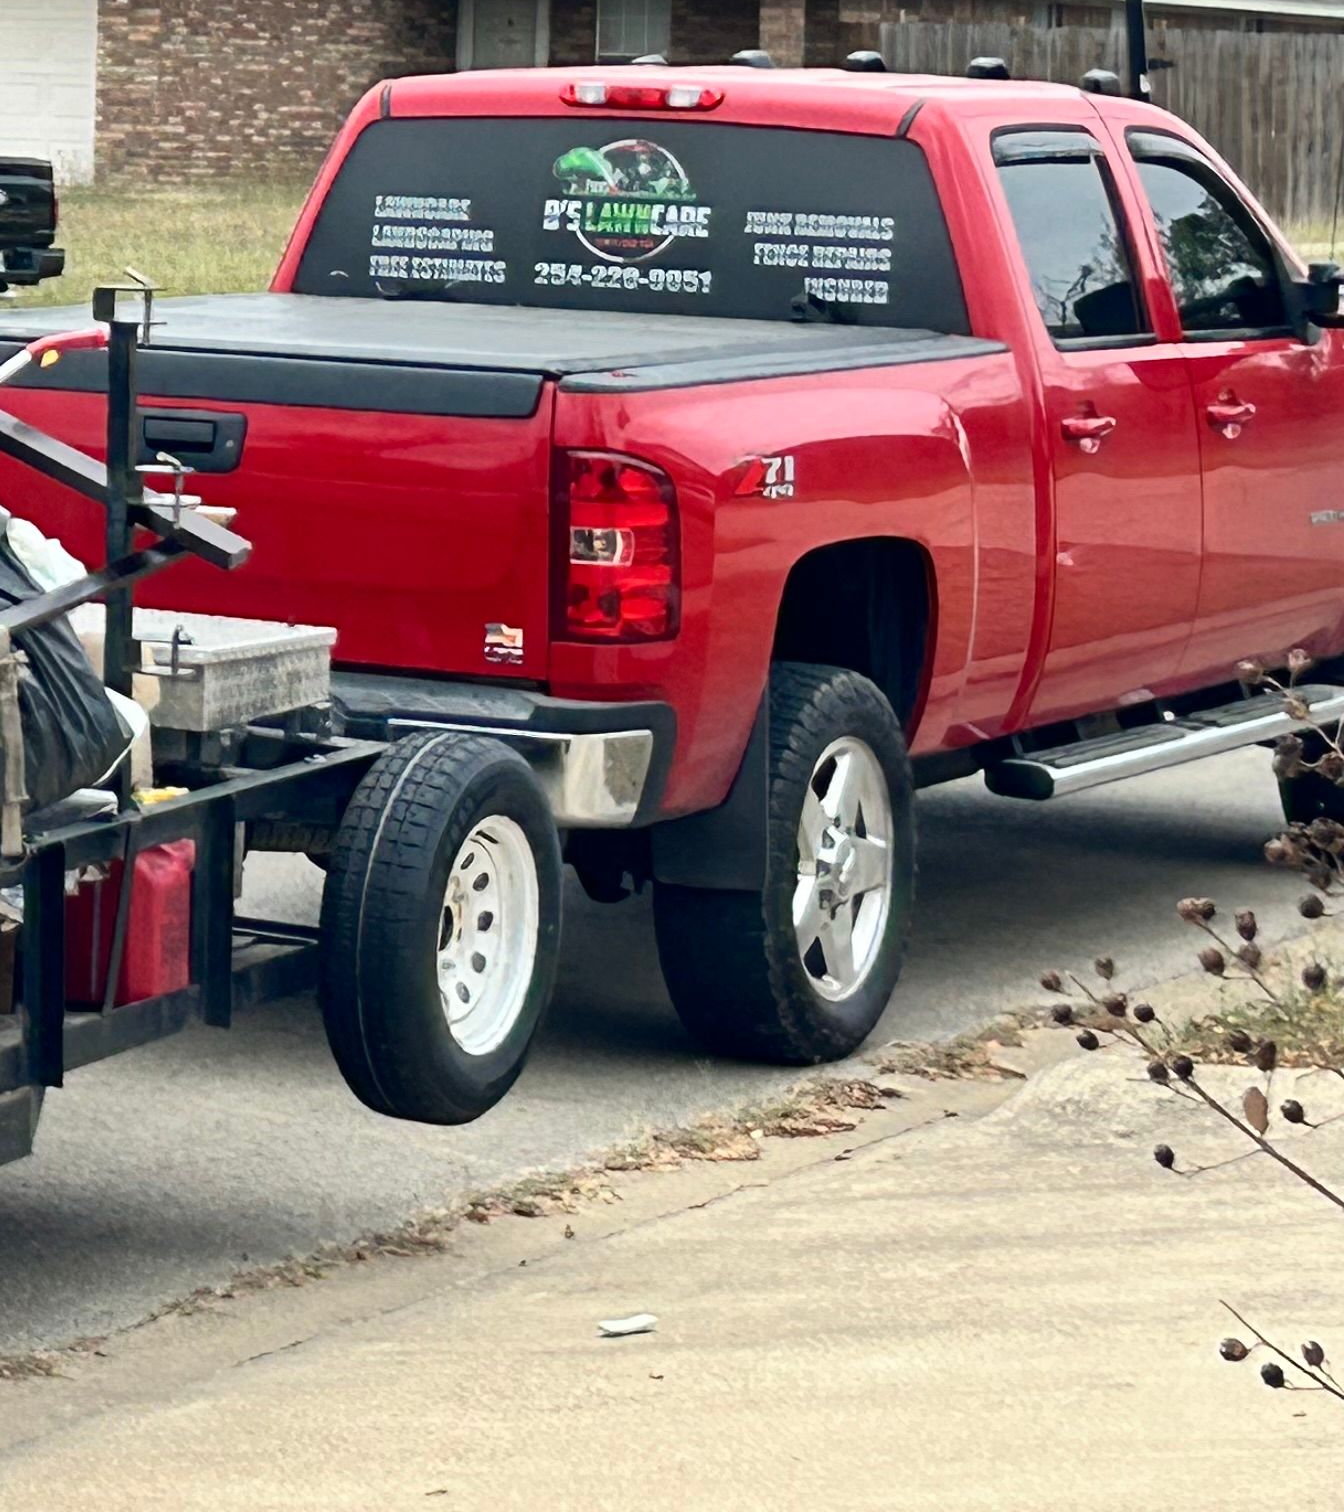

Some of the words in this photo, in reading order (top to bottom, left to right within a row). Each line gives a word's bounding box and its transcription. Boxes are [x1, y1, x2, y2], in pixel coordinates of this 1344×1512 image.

[542, 199, 583, 231] D'S
[584, 201, 712, 238] LAWNCARE
[371, 224, 494, 253] LANDSCAPING
[368, 255, 410, 279] FREE
[410, 256, 507, 284] ESTIMATES
[533, 262, 713, 294] 254-220-9051
